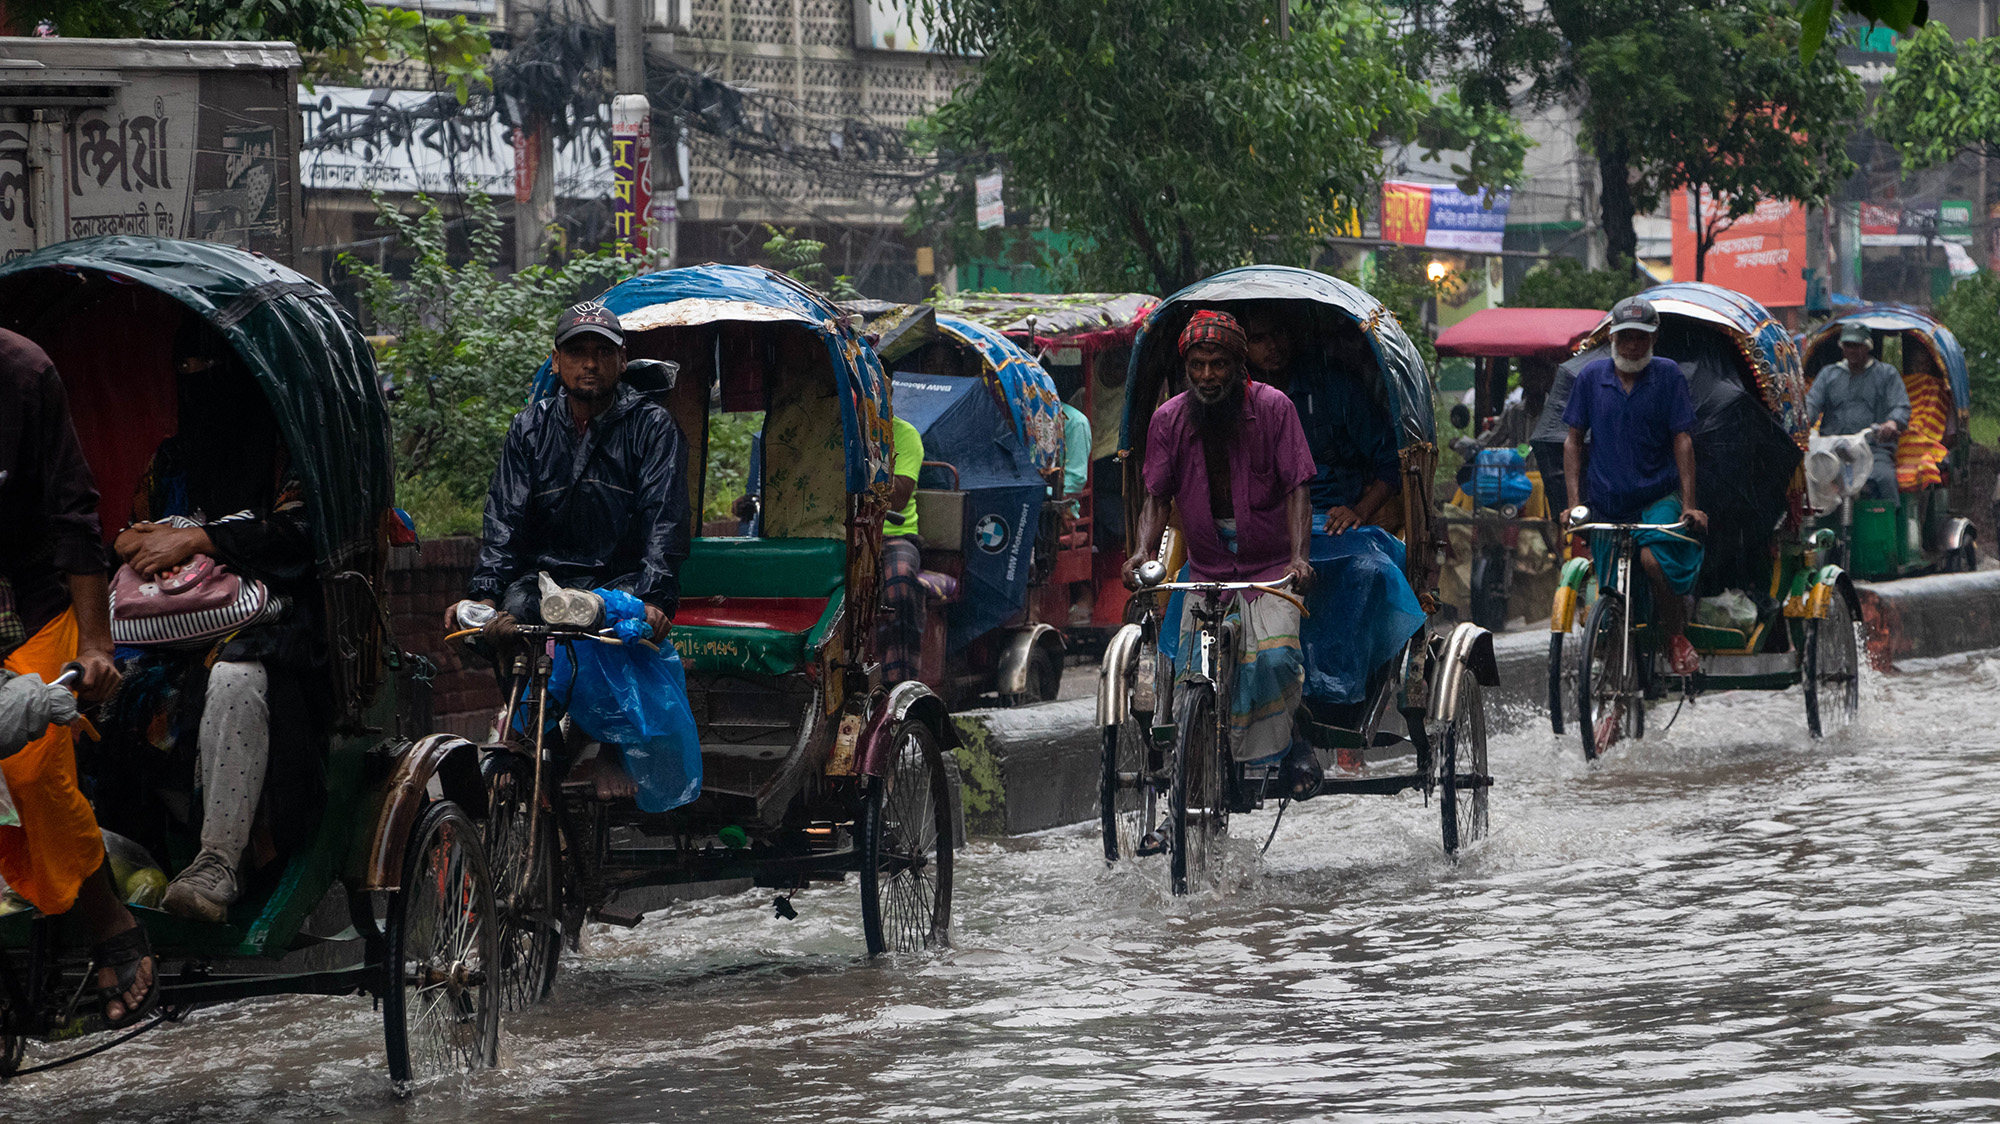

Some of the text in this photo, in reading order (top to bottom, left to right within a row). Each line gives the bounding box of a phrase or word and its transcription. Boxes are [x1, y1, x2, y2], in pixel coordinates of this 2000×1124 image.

[926, 384, 952, 392] BMW
[1007, 503, 1030, 581] BMW Motorsport
